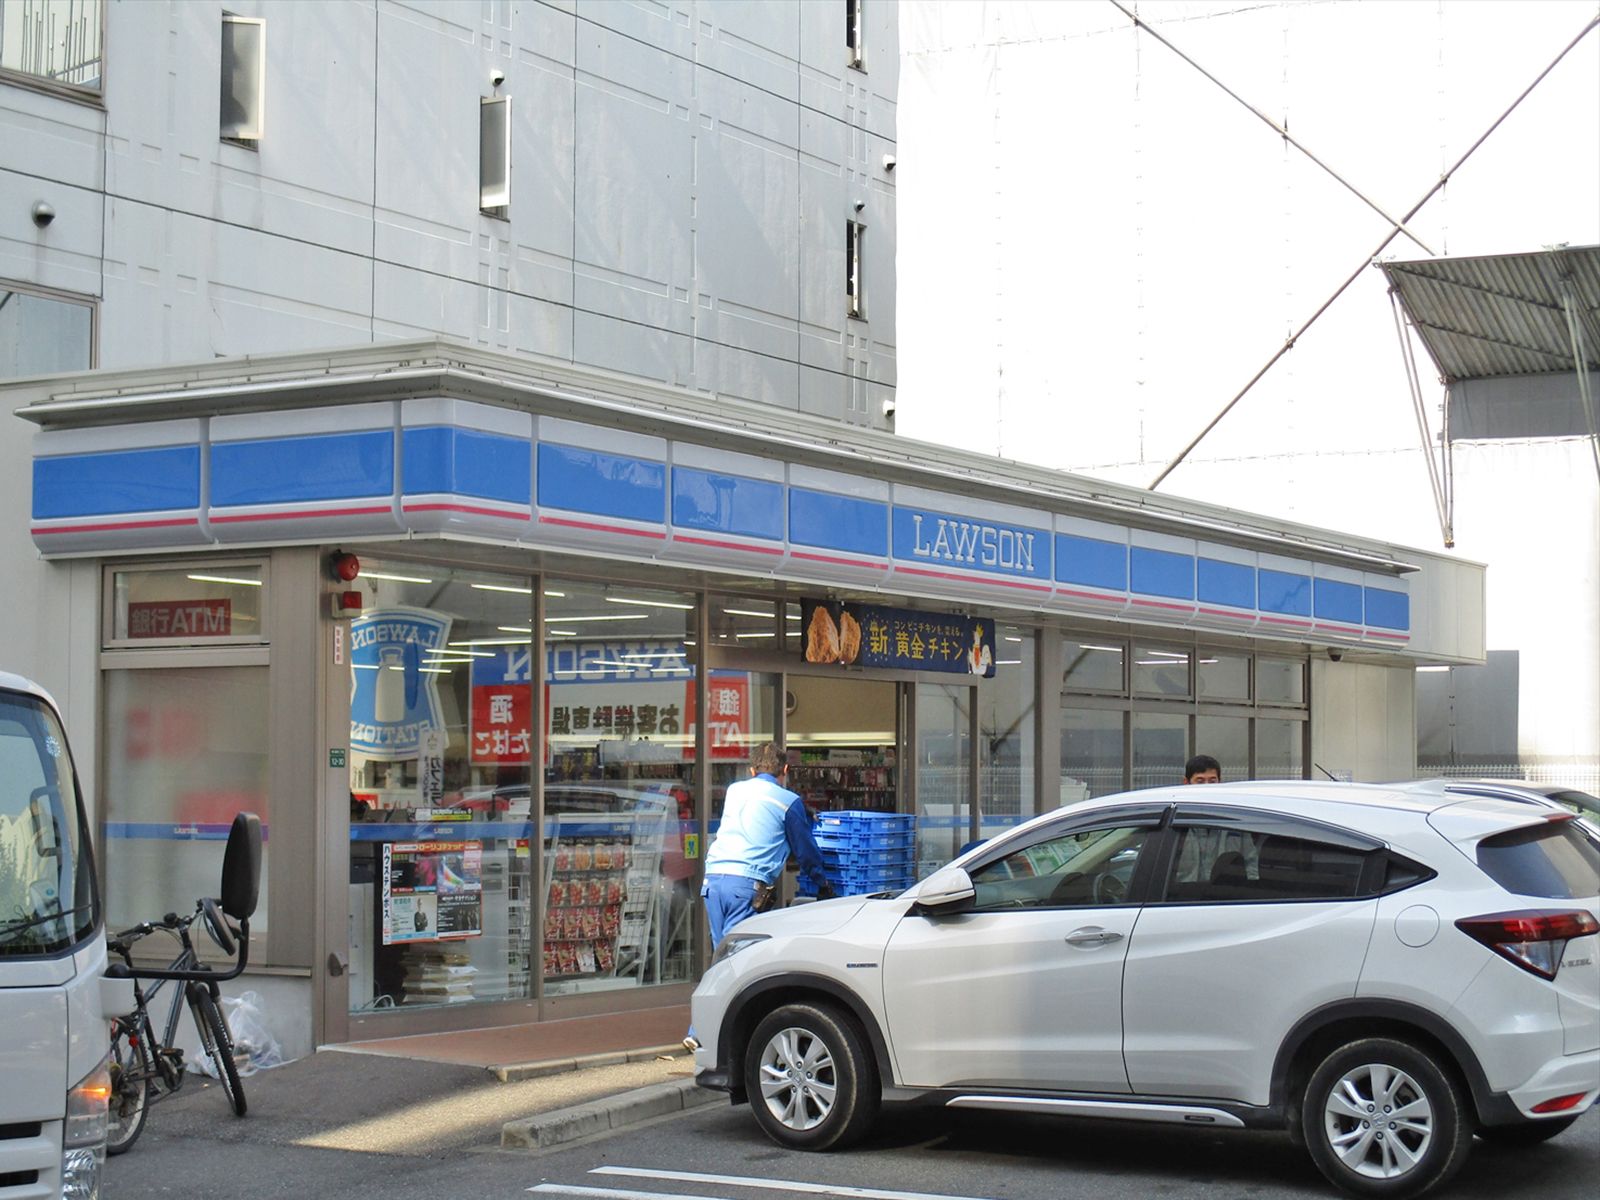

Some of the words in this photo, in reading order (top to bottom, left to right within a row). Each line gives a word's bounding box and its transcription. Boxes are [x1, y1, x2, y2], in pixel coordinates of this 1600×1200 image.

[913, 514, 1034, 571] LAWSON
[131, 606, 225, 634] 銀行ATM
[869, 619, 889, 655] 新
[895, 630, 964, 661] 黄金チキン
